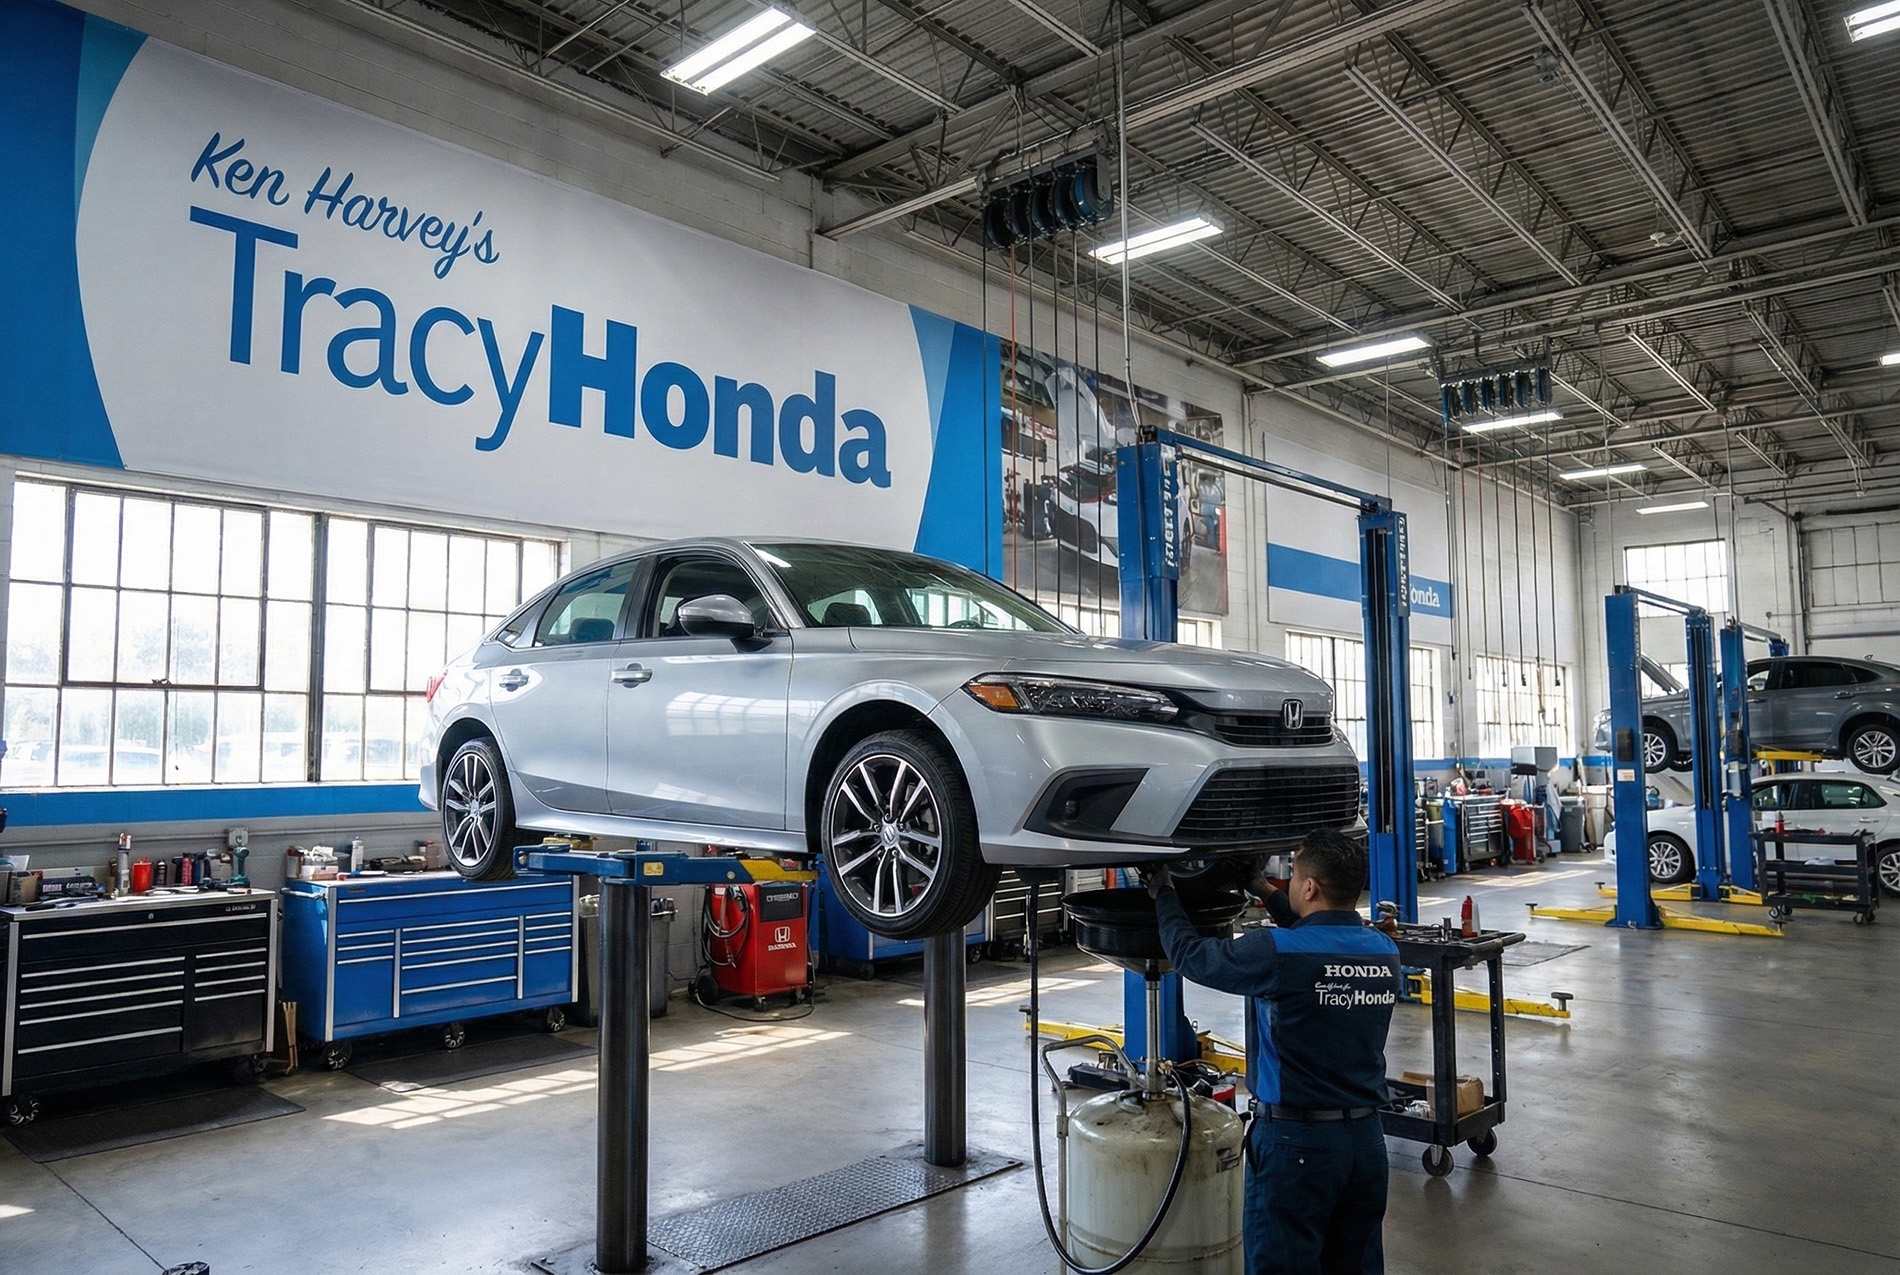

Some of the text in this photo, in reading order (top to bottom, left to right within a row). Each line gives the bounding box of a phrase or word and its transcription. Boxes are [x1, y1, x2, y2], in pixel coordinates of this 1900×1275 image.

[191, 131, 500, 280] Ken Harvey's
[1409, 583, 1441, 608] onda
[1323, 964, 1393, 978] HONDA
